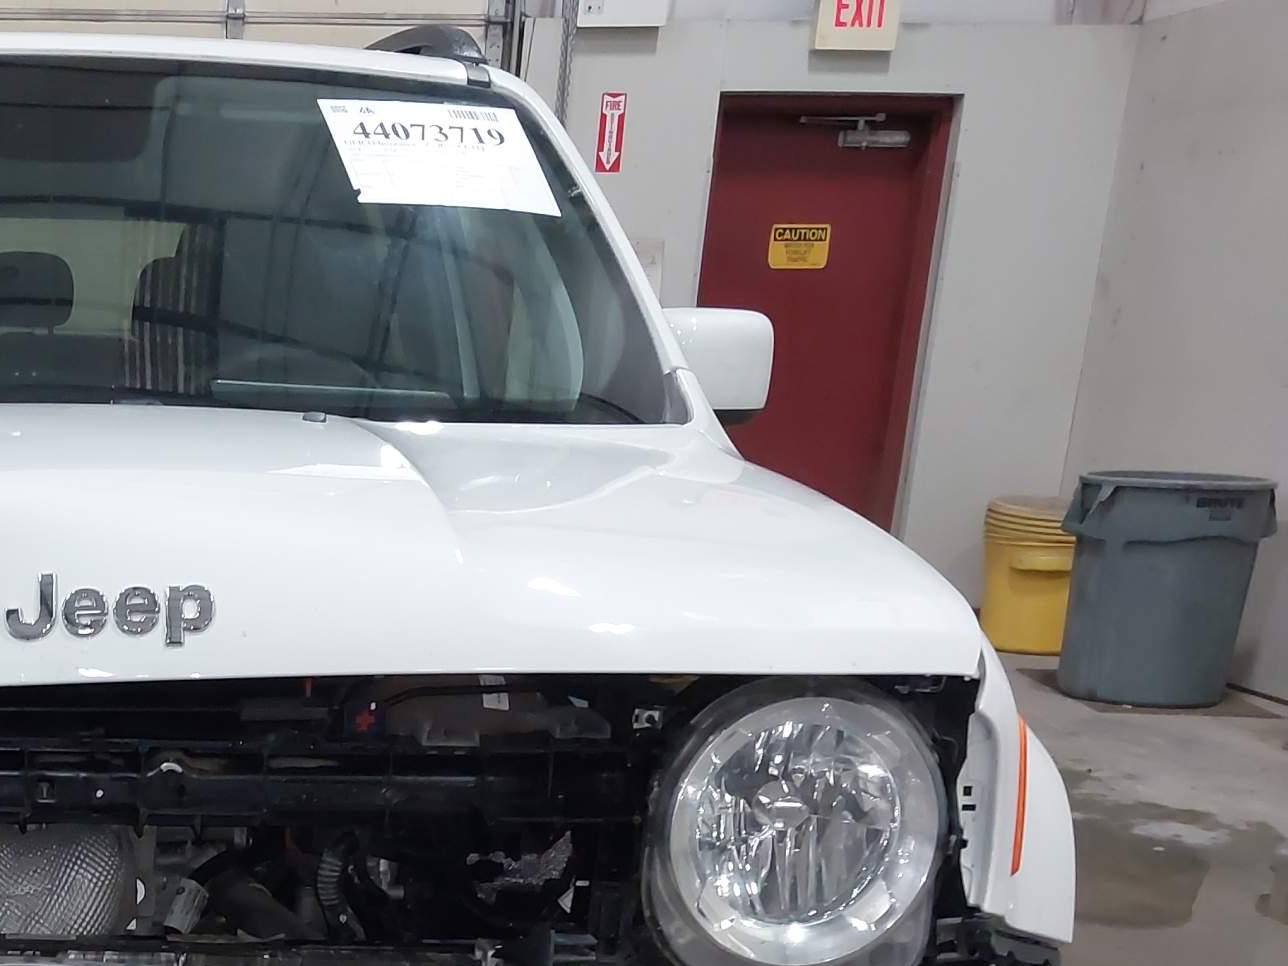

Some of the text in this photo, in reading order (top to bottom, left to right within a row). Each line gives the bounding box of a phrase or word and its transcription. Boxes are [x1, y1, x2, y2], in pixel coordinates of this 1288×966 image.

[605, 100, 623, 111] FIRE
[353, 121, 505, 146] 44073719
[775, 228, 826, 241] CAUTION
[5, 573, 216, 648] Jeep
